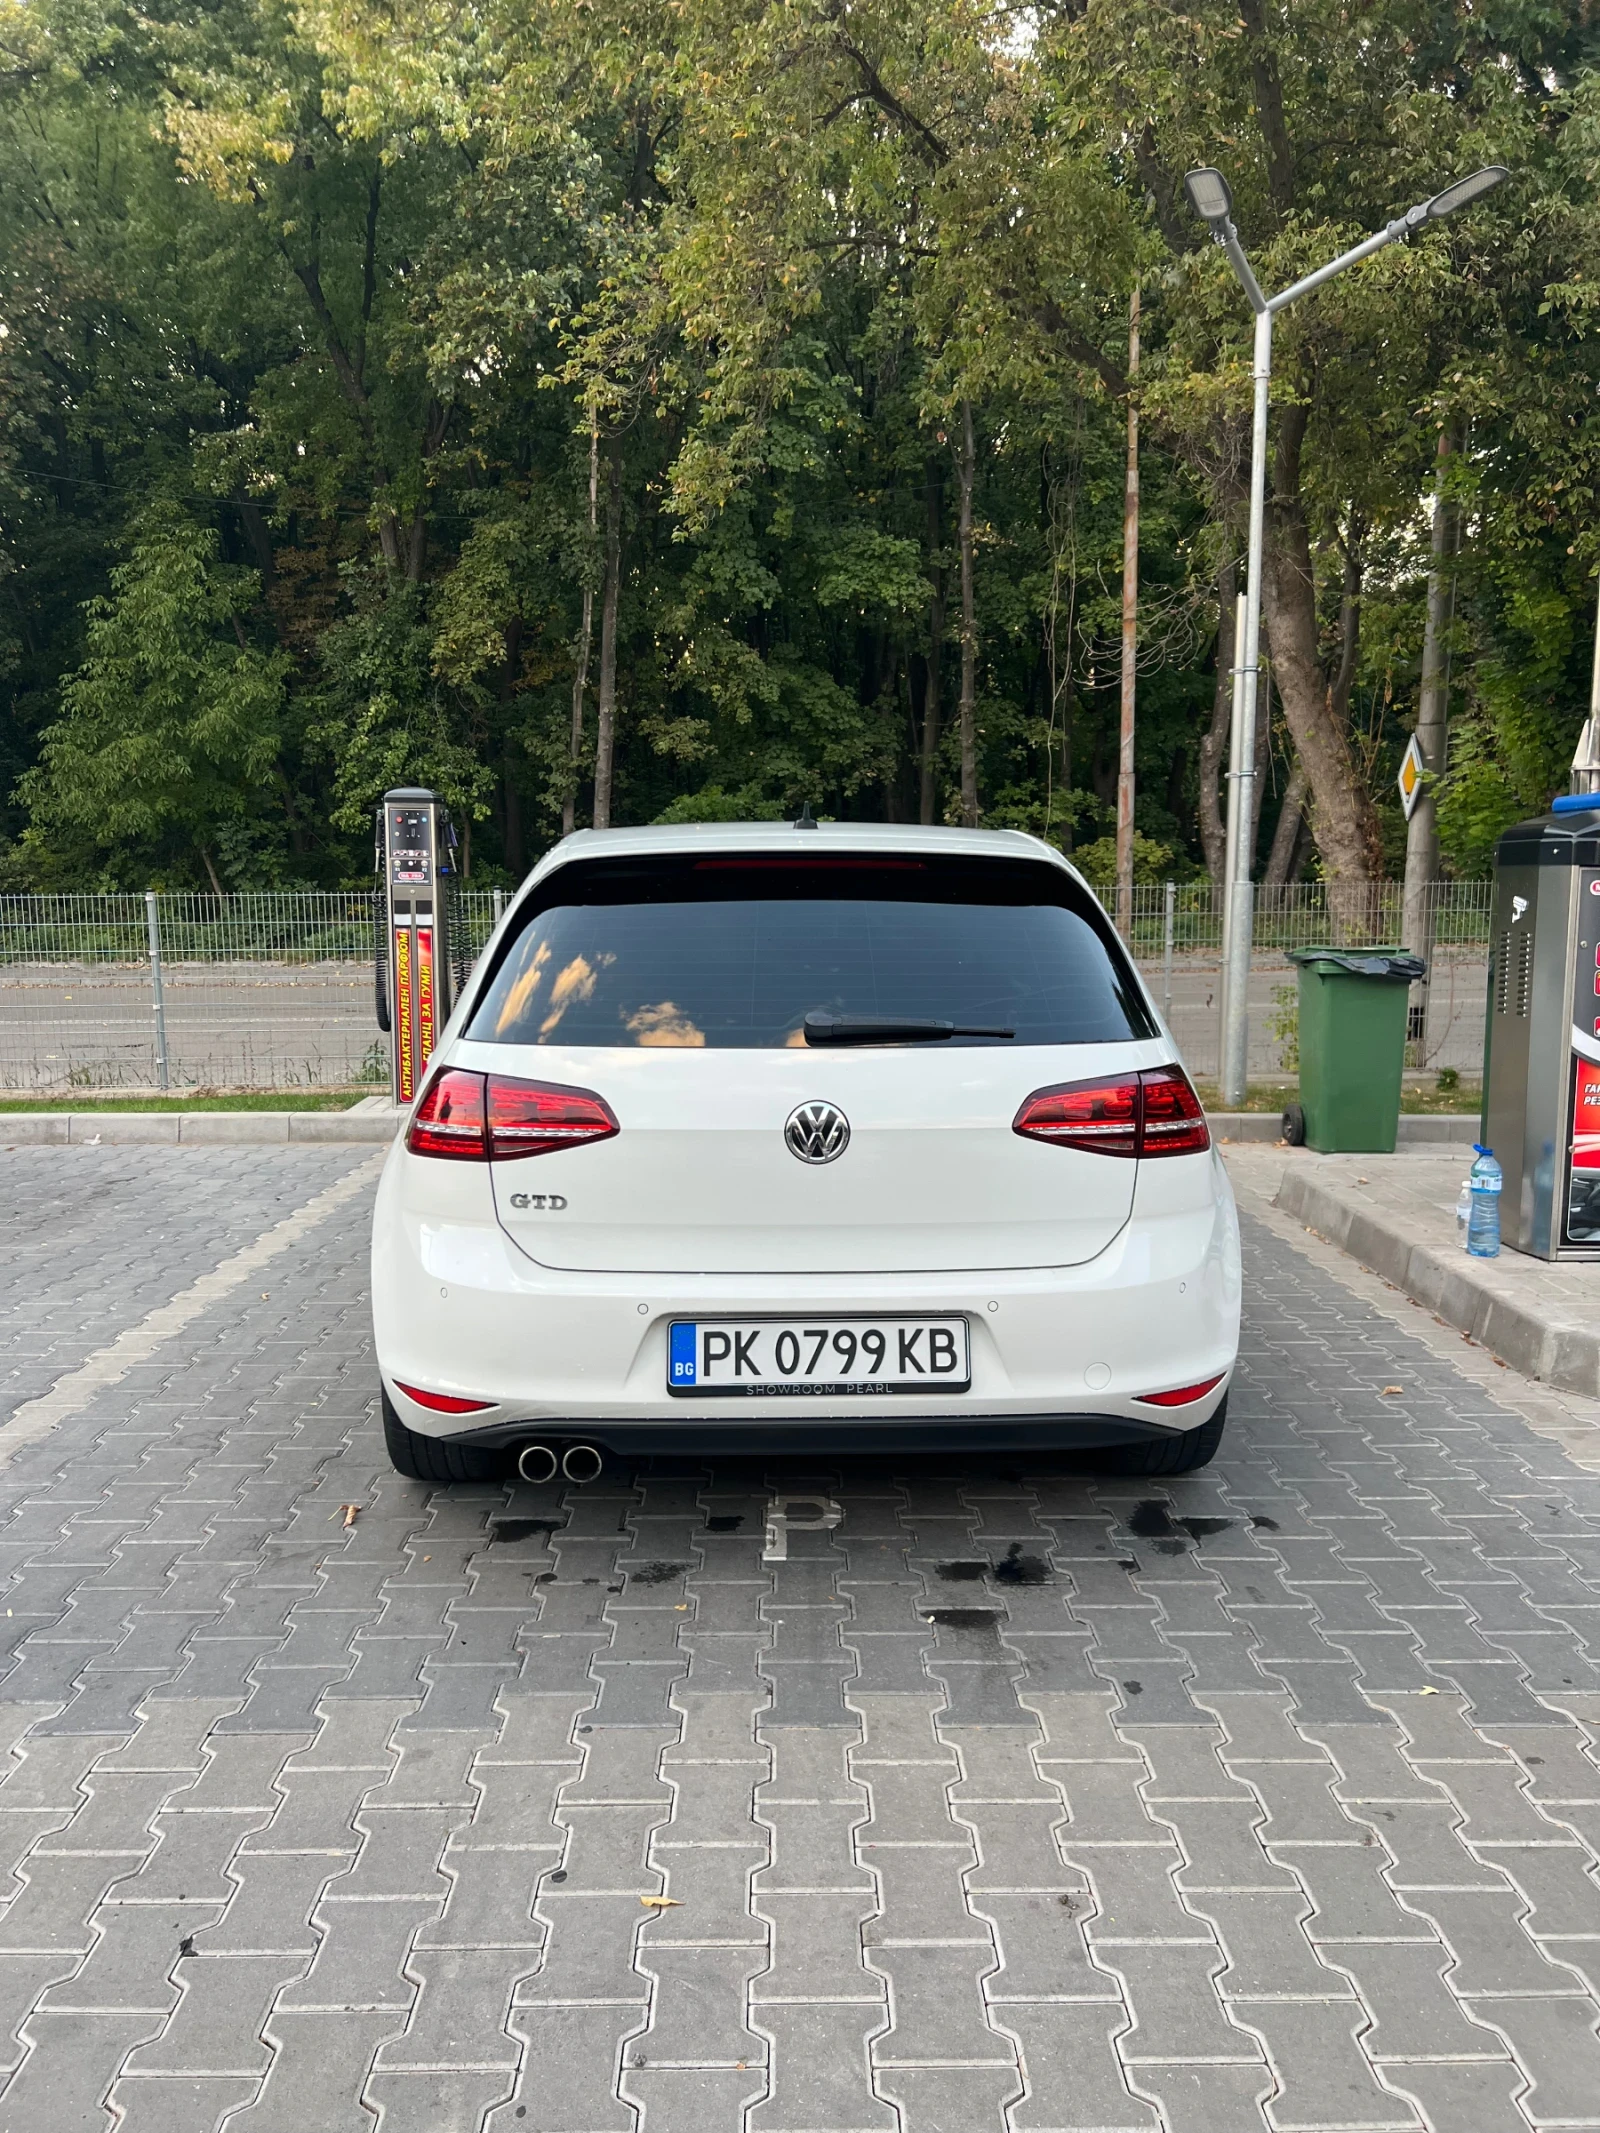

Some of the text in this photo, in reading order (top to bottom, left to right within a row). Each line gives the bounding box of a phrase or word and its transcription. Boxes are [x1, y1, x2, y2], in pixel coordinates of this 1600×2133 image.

[421, 965, 430, 999] ГУМИ
[399, 932, 412, 1098] АНТИБАКТЕРИАЛЕН ПАРФЮМ
[422, 1003, 431, 1018] ЗА
[510, 1193, 568, 1210] GTD
[703, 1328, 958, 1377] PK 0799 KB
[674, 1362, 694, 1377] BG
[746, 1383, 893, 1396] SHOWROOM PEARL
[763, 1495, 842, 1561] P
